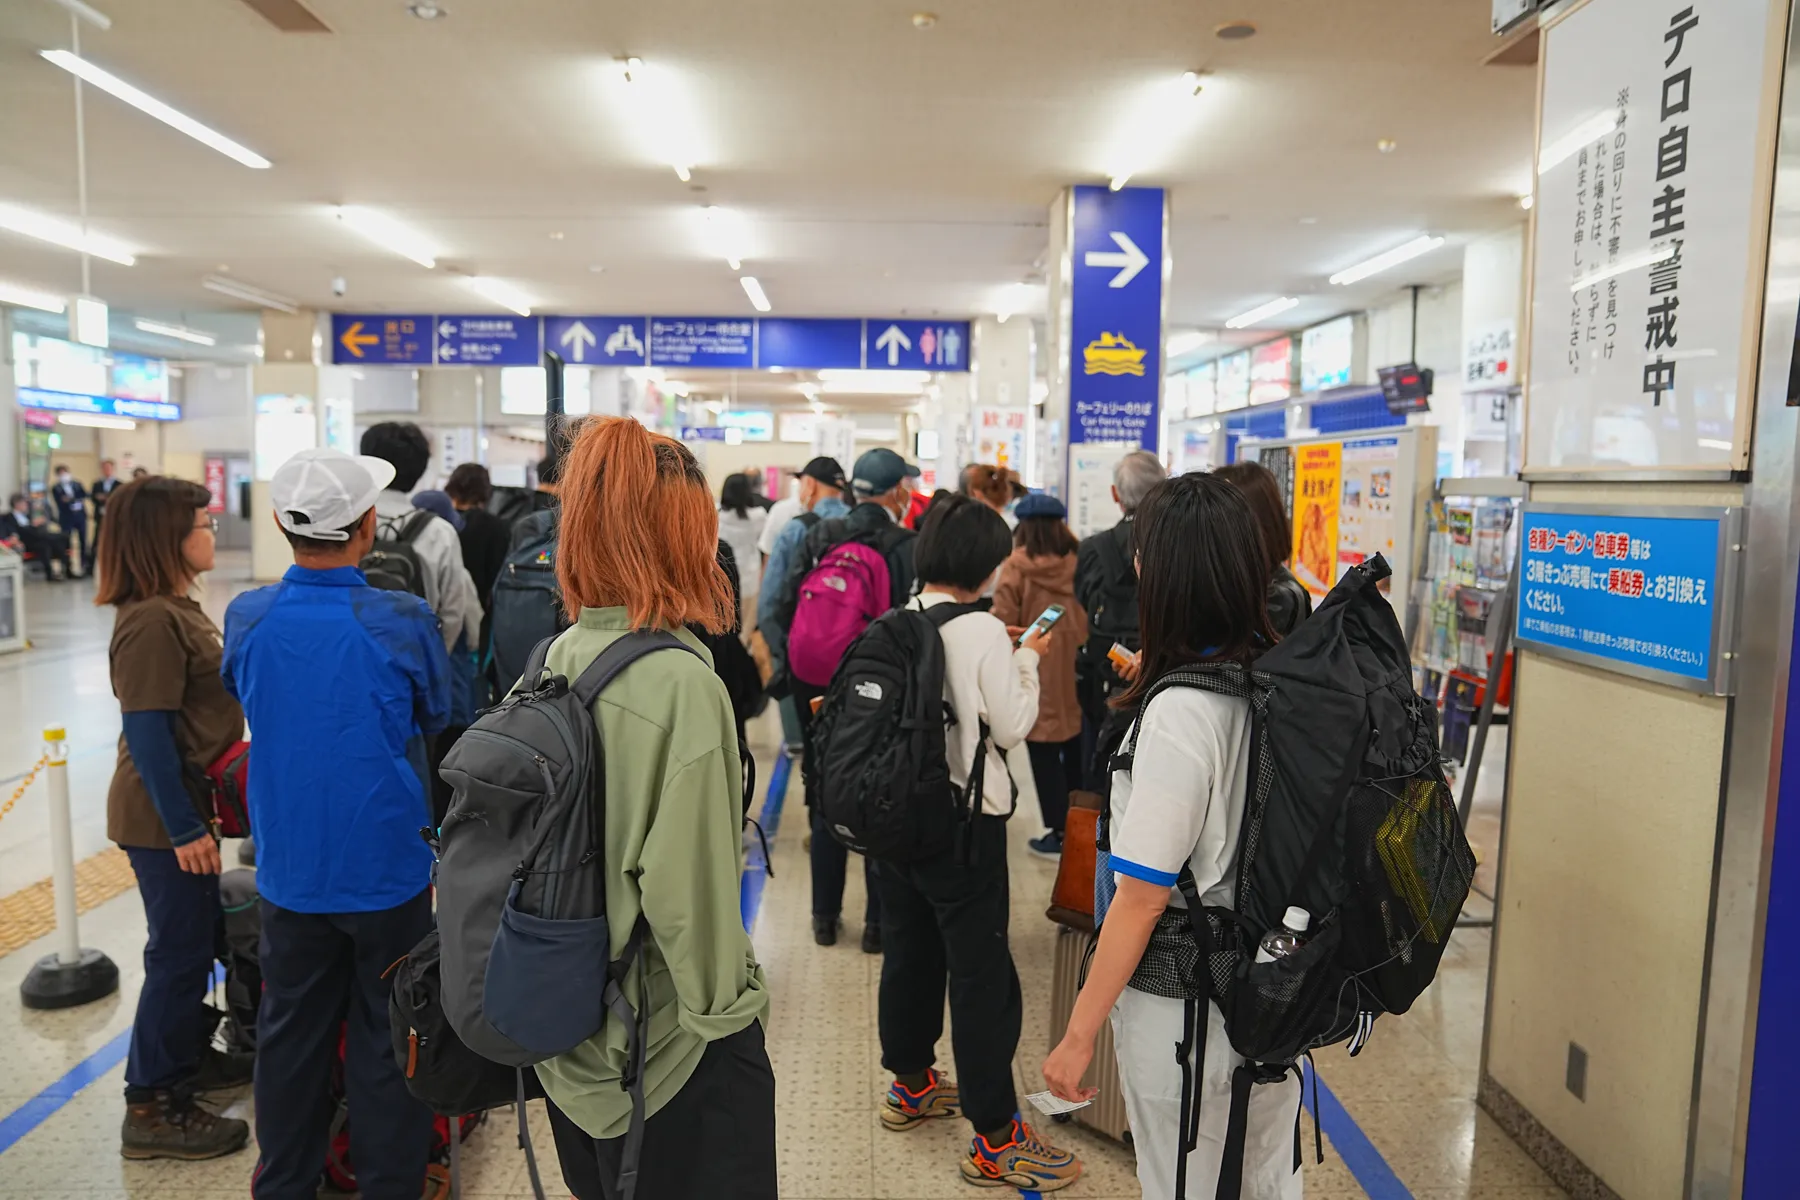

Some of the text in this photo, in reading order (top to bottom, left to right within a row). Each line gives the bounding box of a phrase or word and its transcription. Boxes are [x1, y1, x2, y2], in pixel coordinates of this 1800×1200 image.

[1642, 5, 1699, 406] テロ自主警戒中
[1603, 86, 1630, 360] ※身の回りに不審を見つけ
[1076, 400, 1153, 416] カーフェリーのりば
[1080, 415, 1097, 427] Car
[1098, 415, 1122, 428] Ferry
[1525, 588, 1565, 615] ください。
